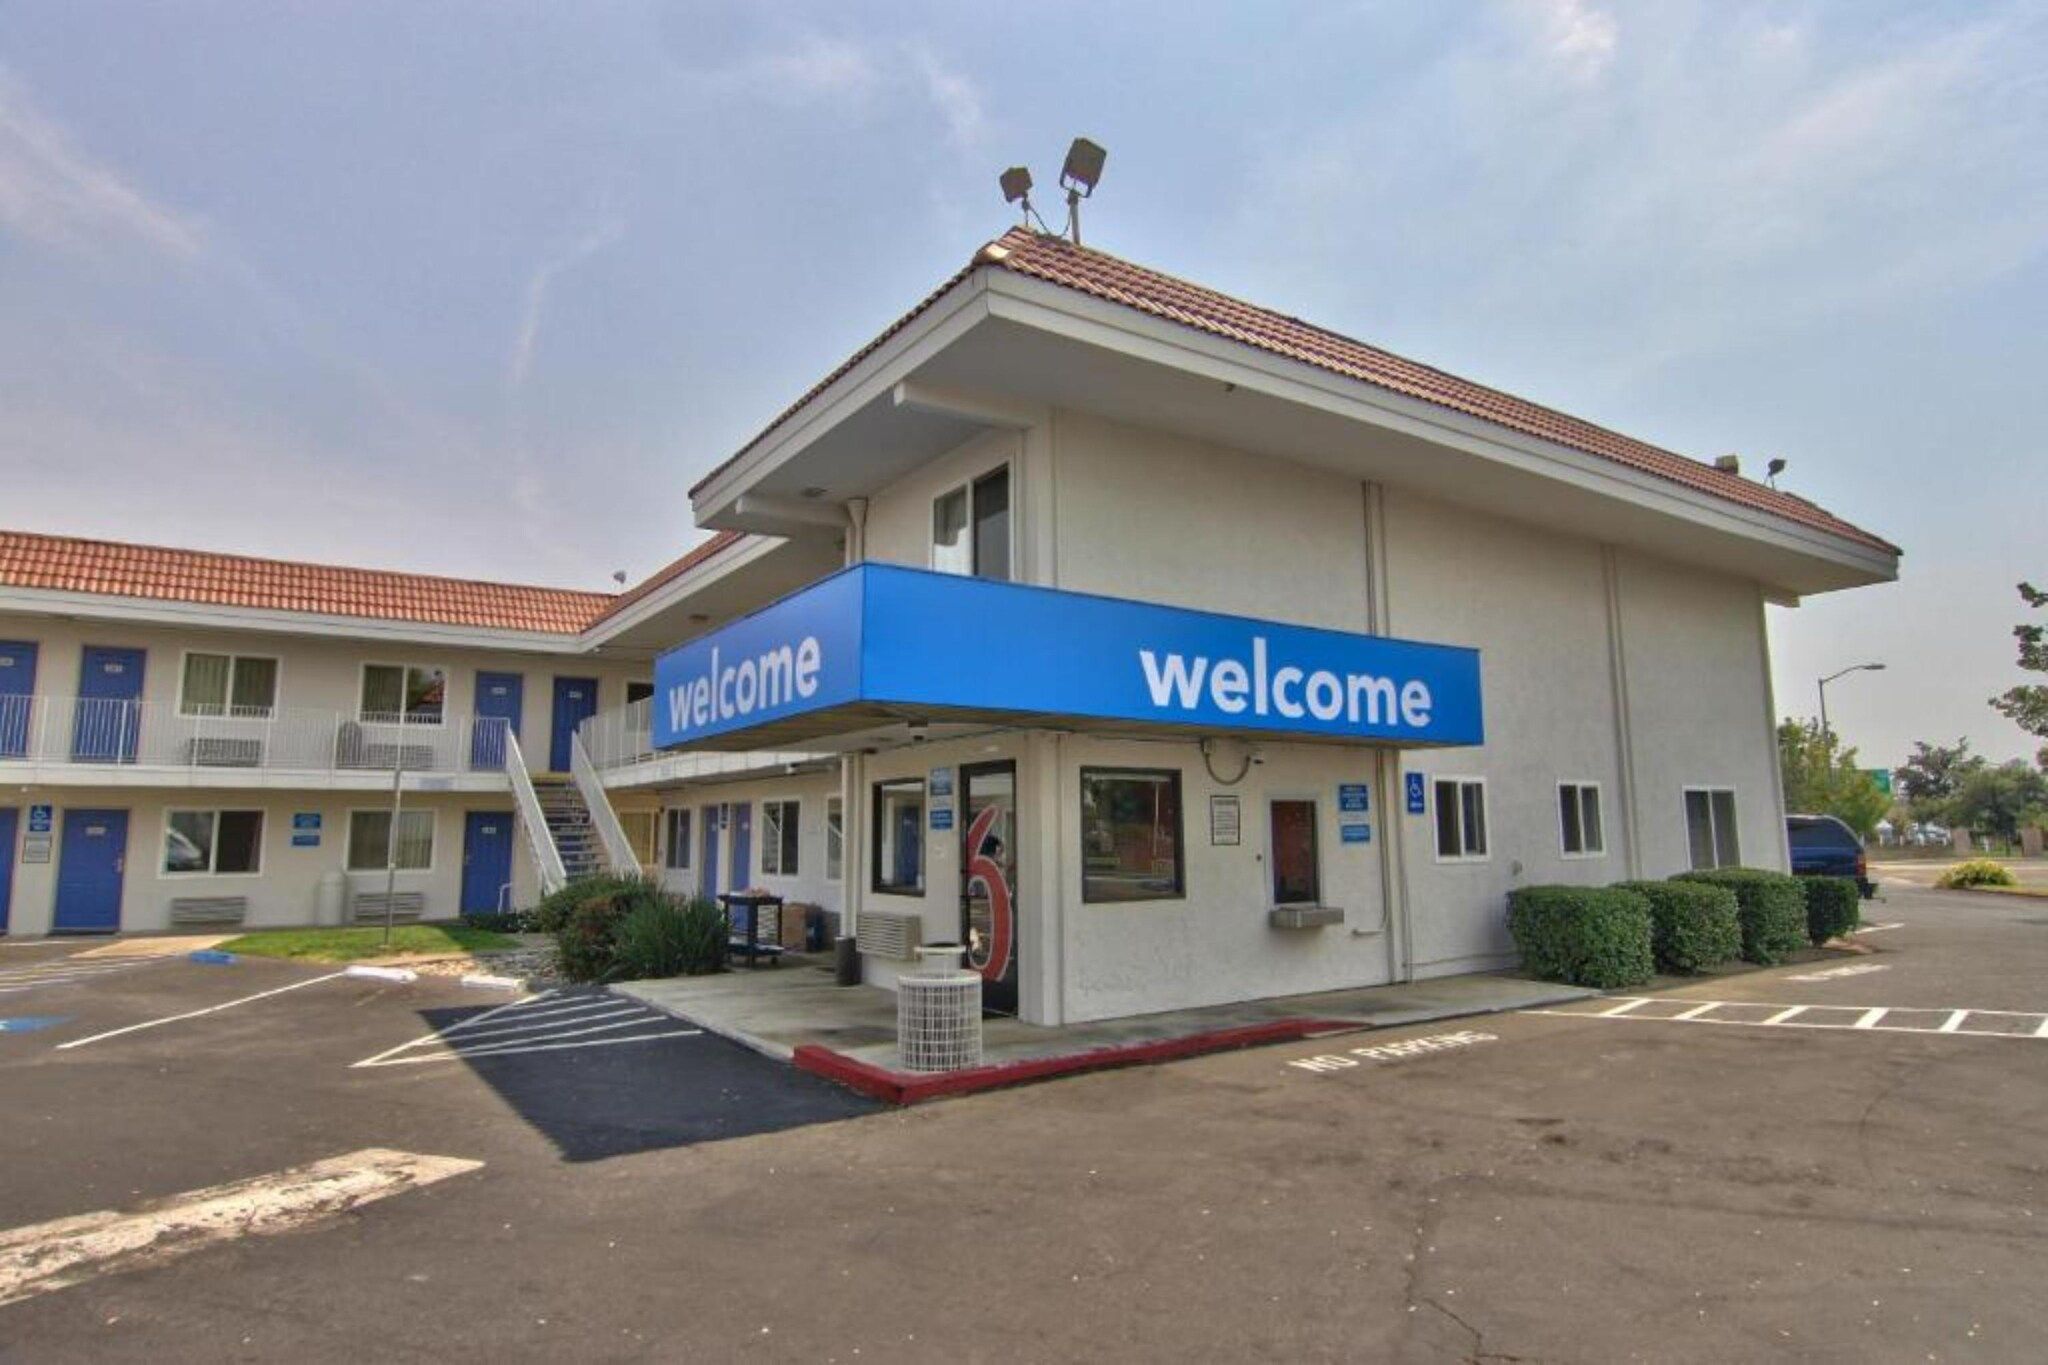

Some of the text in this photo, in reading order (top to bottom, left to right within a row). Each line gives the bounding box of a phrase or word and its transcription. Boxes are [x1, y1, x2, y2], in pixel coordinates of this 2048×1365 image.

[669, 636, 821, 733] welcome
[1139, 637, 1432, 728] welcome
[967, 805, 1013, 982] 6
[1286, 1054, 1359, 1072] NO
